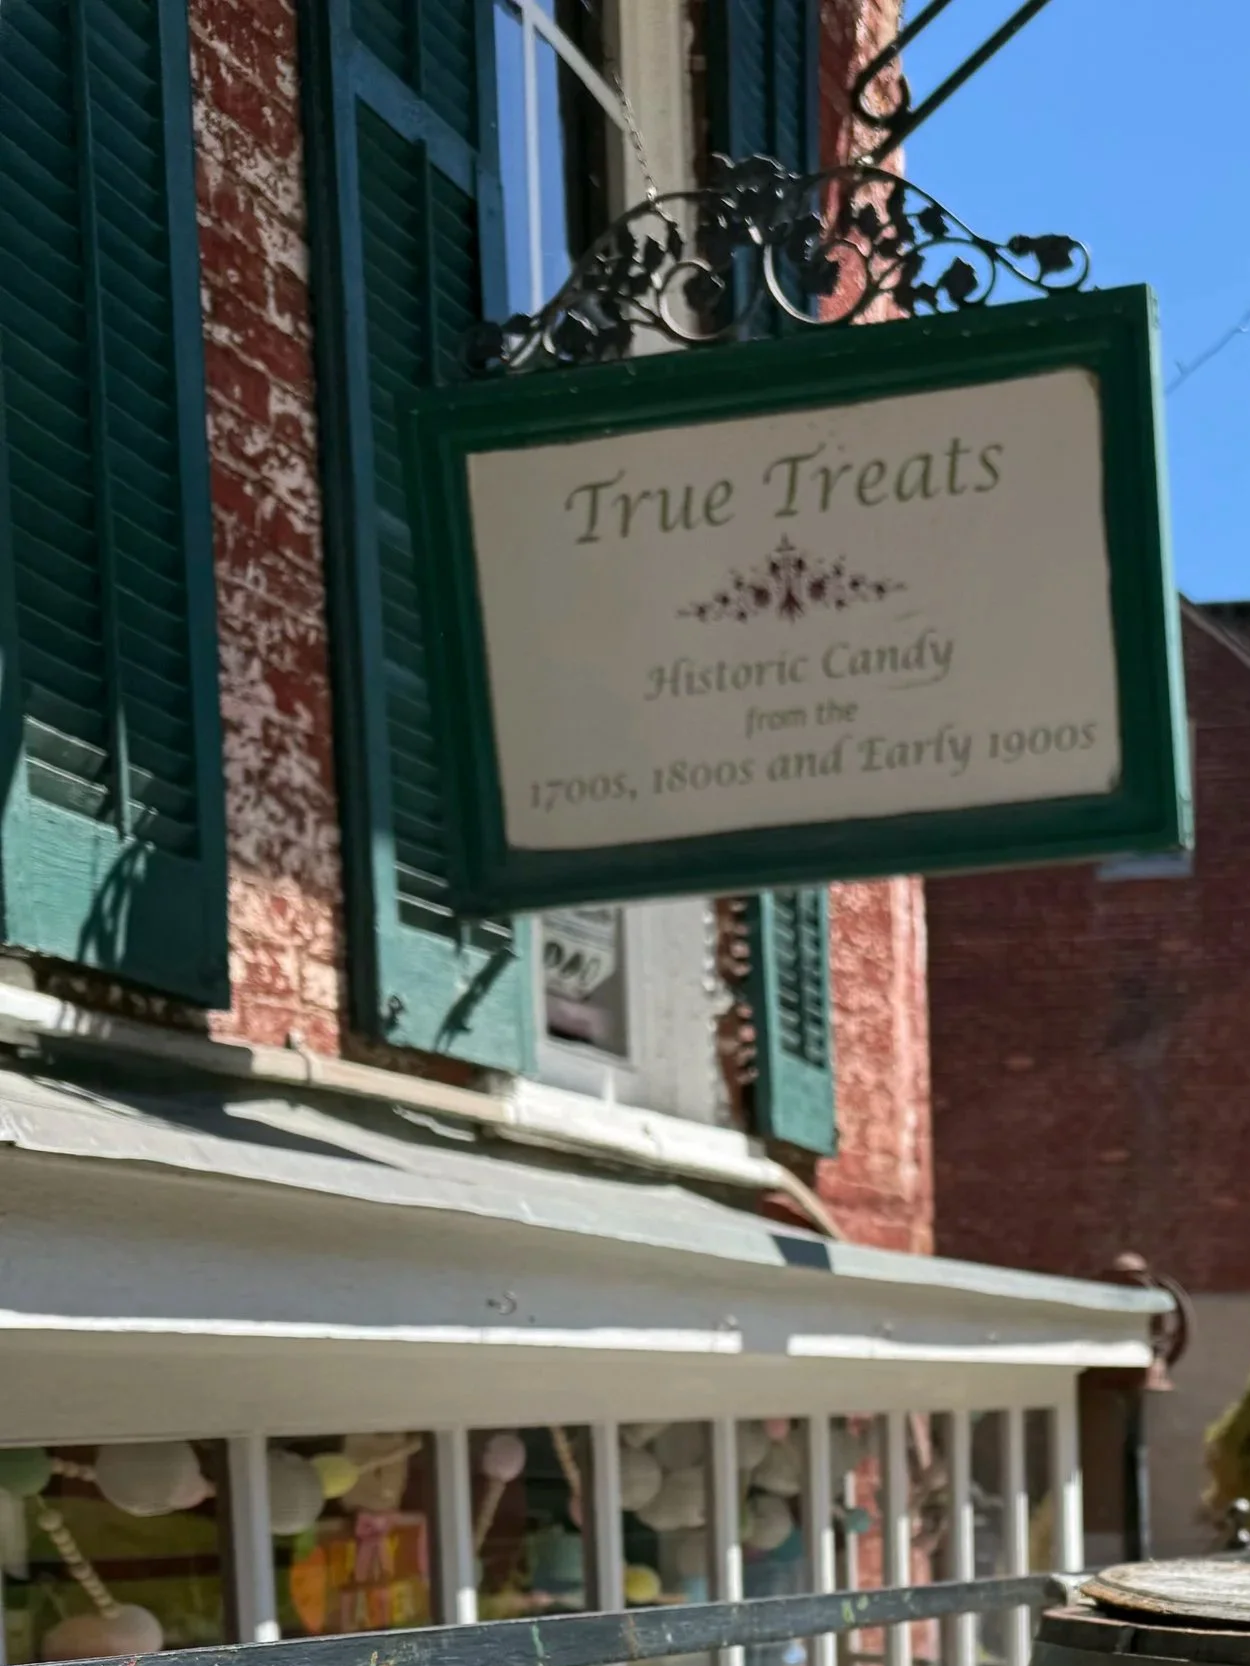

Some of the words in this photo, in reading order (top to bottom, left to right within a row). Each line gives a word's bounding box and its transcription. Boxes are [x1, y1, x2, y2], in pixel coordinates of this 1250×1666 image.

[564, 469, 735, 544] True
[762, 437, 1004, 519] Treats
[642, 656, 807, 700] Historic
[820, 626, 953, 690] Candy
[744, 706, 807, 740] from
[815, 697, 858, 726] the
[530, 771, 638, 814] 1700s,
[651, 756, 756, 795] 1800s
[765, 732, 851, 783] and
[857, 722, 972, 778] Early
[988, 721, 1098, 764] 1900s
